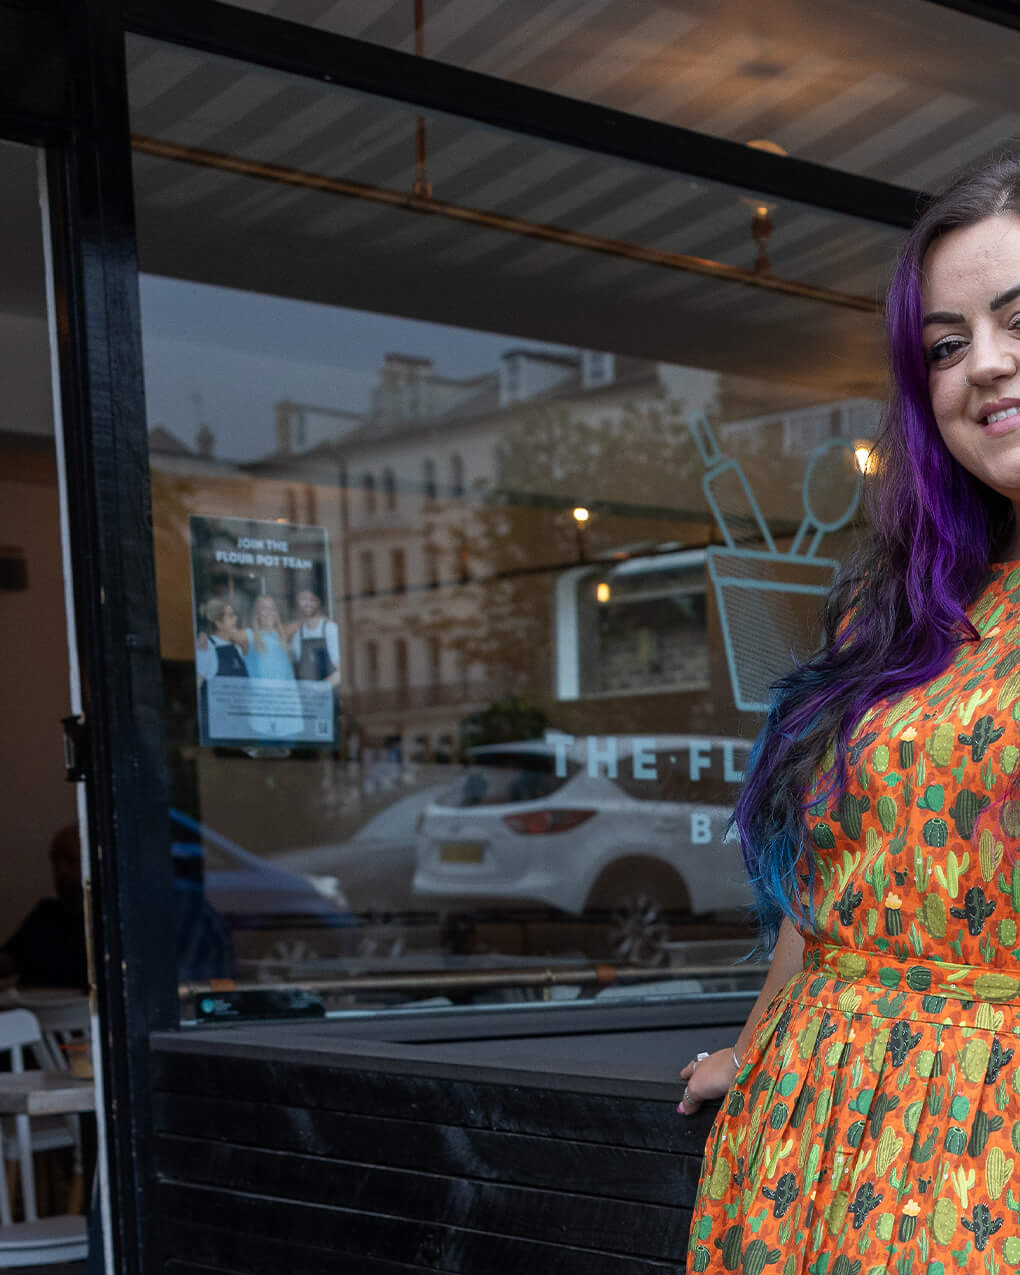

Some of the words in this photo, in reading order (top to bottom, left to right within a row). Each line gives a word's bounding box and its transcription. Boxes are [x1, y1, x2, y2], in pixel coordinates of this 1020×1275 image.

[237, 538, 264, 549] JOIN
[266, 540, 289, 553] THE
[216, 551, 255, 564] FLOUR
[256, 554, 280, 567] POT
[282, 556, 313, 569] TEAM
[545, 734, 659, 780] THE
[690, 740, 746, 782] FL
